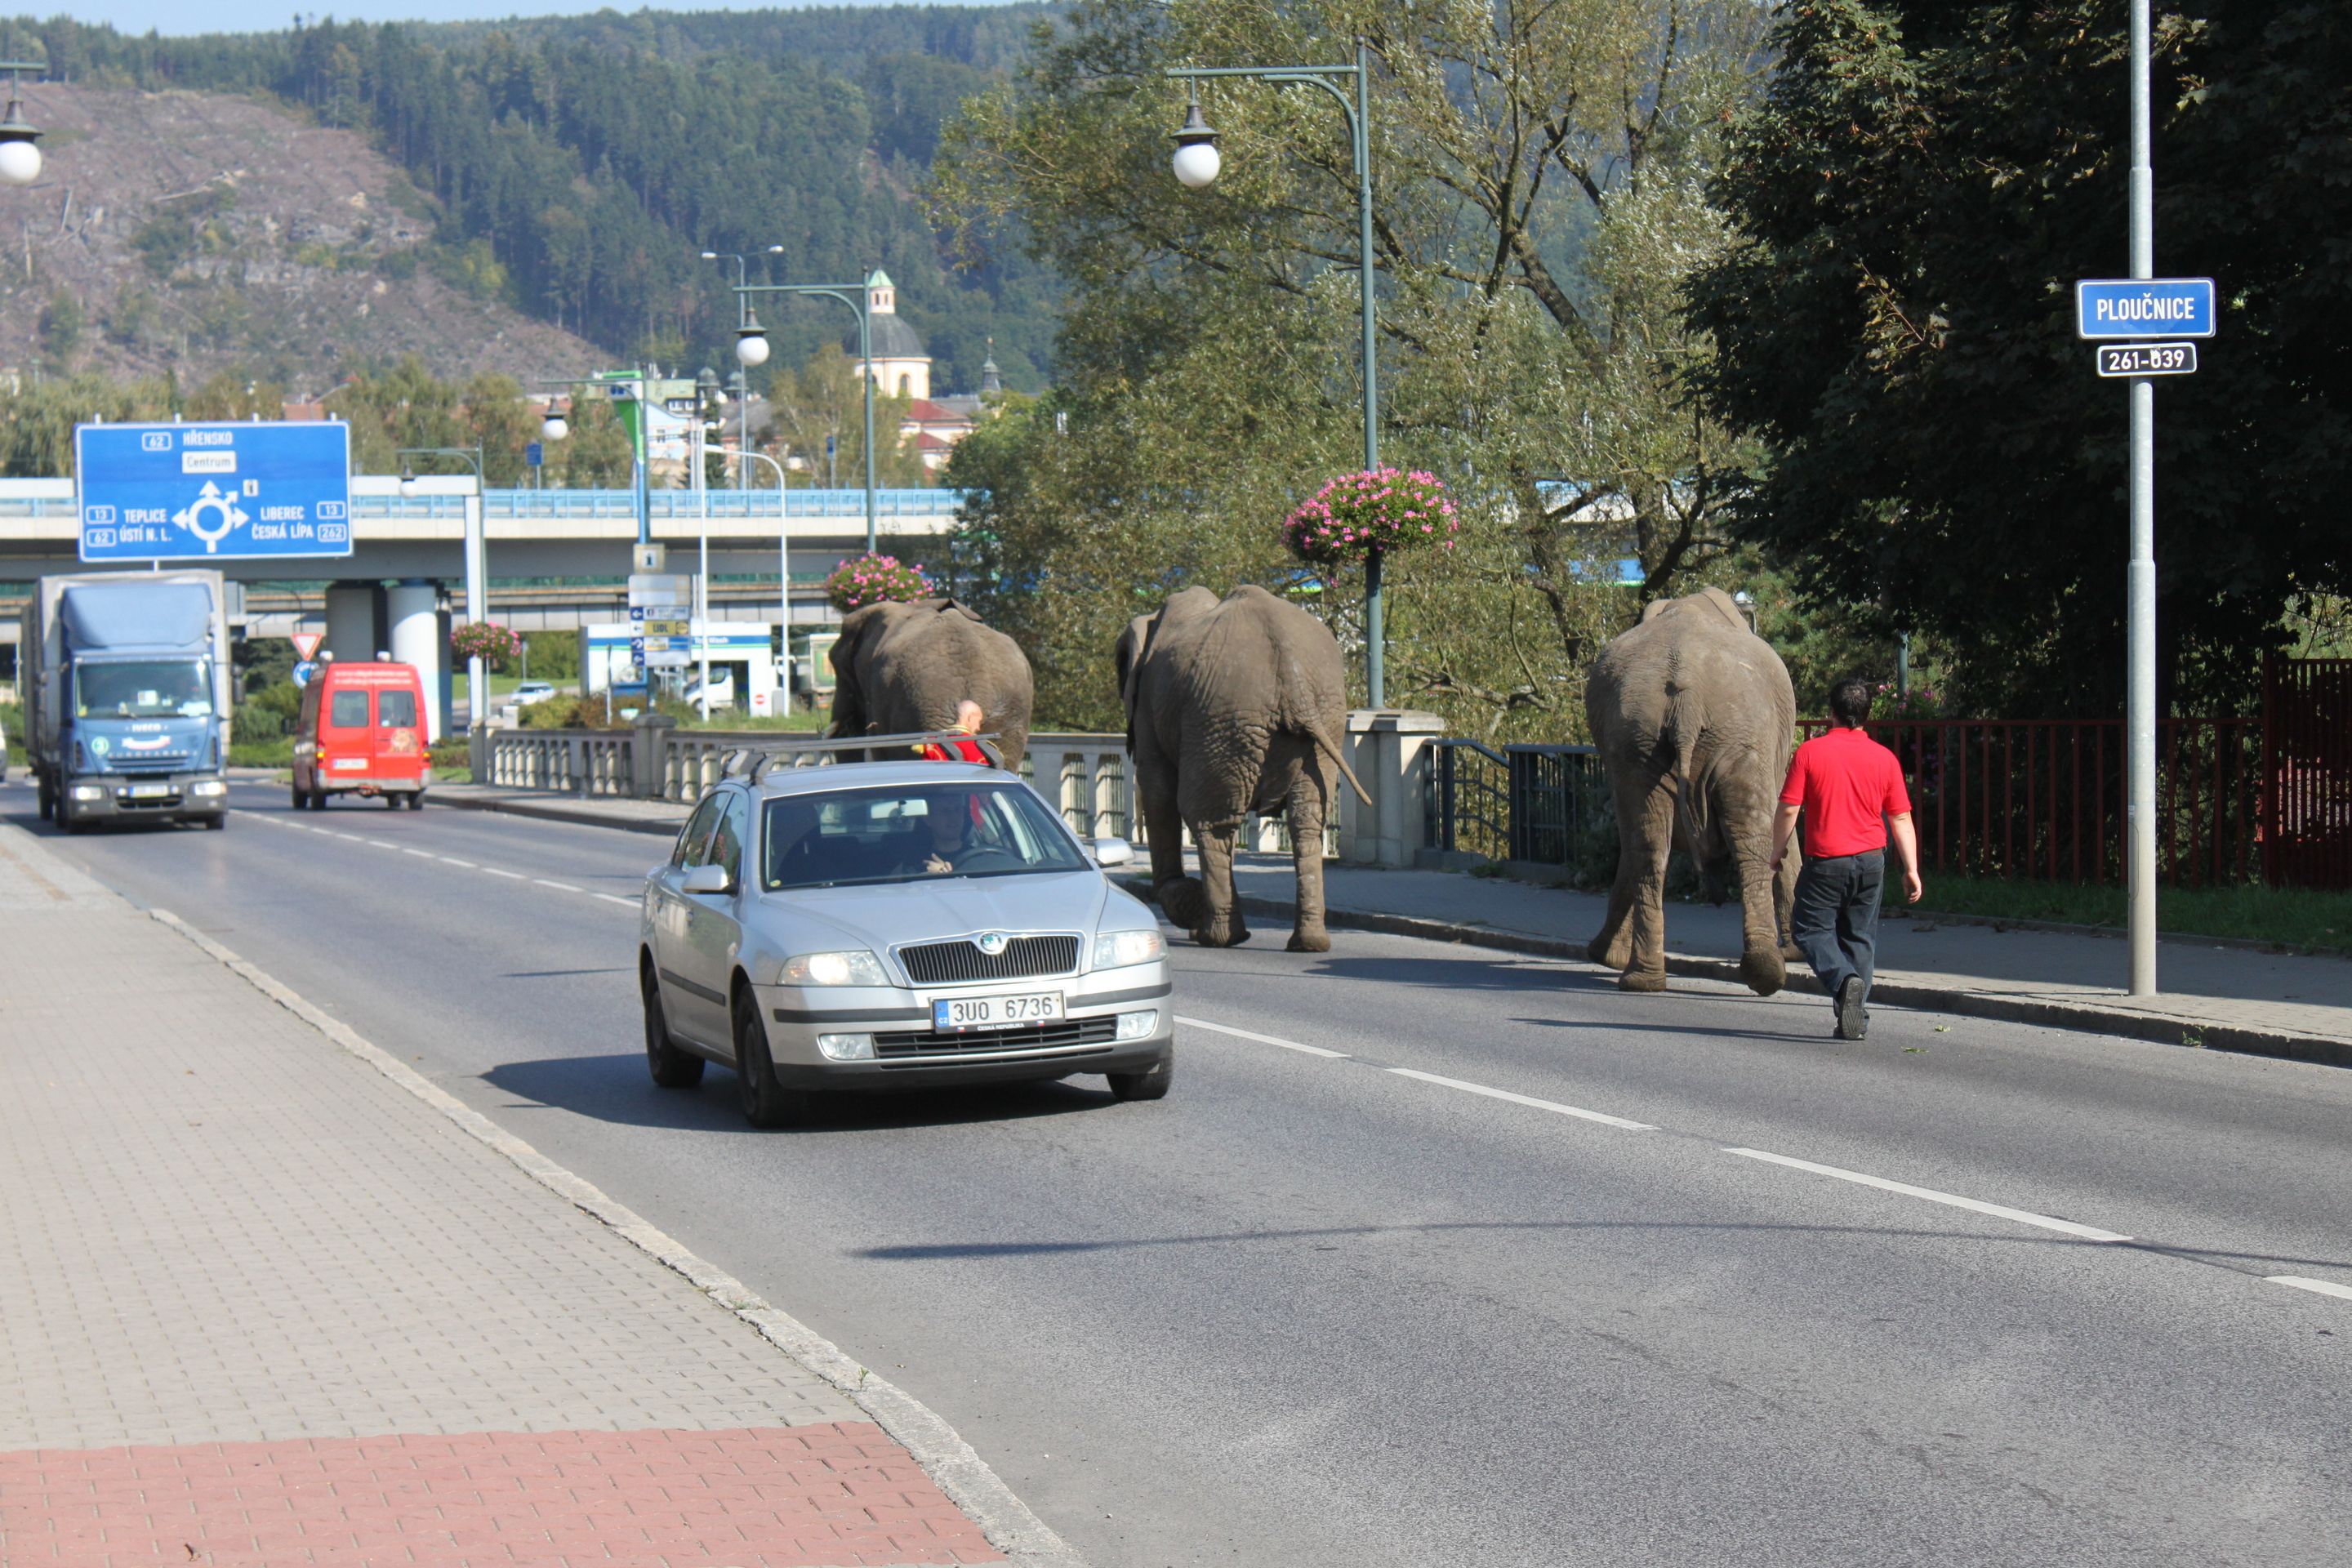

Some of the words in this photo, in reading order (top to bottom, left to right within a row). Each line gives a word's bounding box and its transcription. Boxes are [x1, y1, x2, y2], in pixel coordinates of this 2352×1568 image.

[2096, 292, 2195, 321] PLOUČNICE
[2109, 350, 2185, 371] 261-039
[149, 435, 164, 448] 62
[182, 430, 234, 446] HŘENSKO
[186, 457, 231, 467] Centrum
[94, 510, 107, 521] 13
[124, 509, 167, 523] TEPLICE
[260, 506, 304, 520] LIBEREC
[325, 504, 337, 516] 13
[93, 532, 109, 544] 62
[120, 526, 144, 542] ÚSTÍ
[161, 527, 172, 541] L.
[252, 523, 286, 540] ČESKÁ
[291, 522, 314, 538] LÍPA
[321, 527, 343, 540] 262
[131, 724, 162, 732] IVECO
[1005, 996, 1053, 1018] 6736
